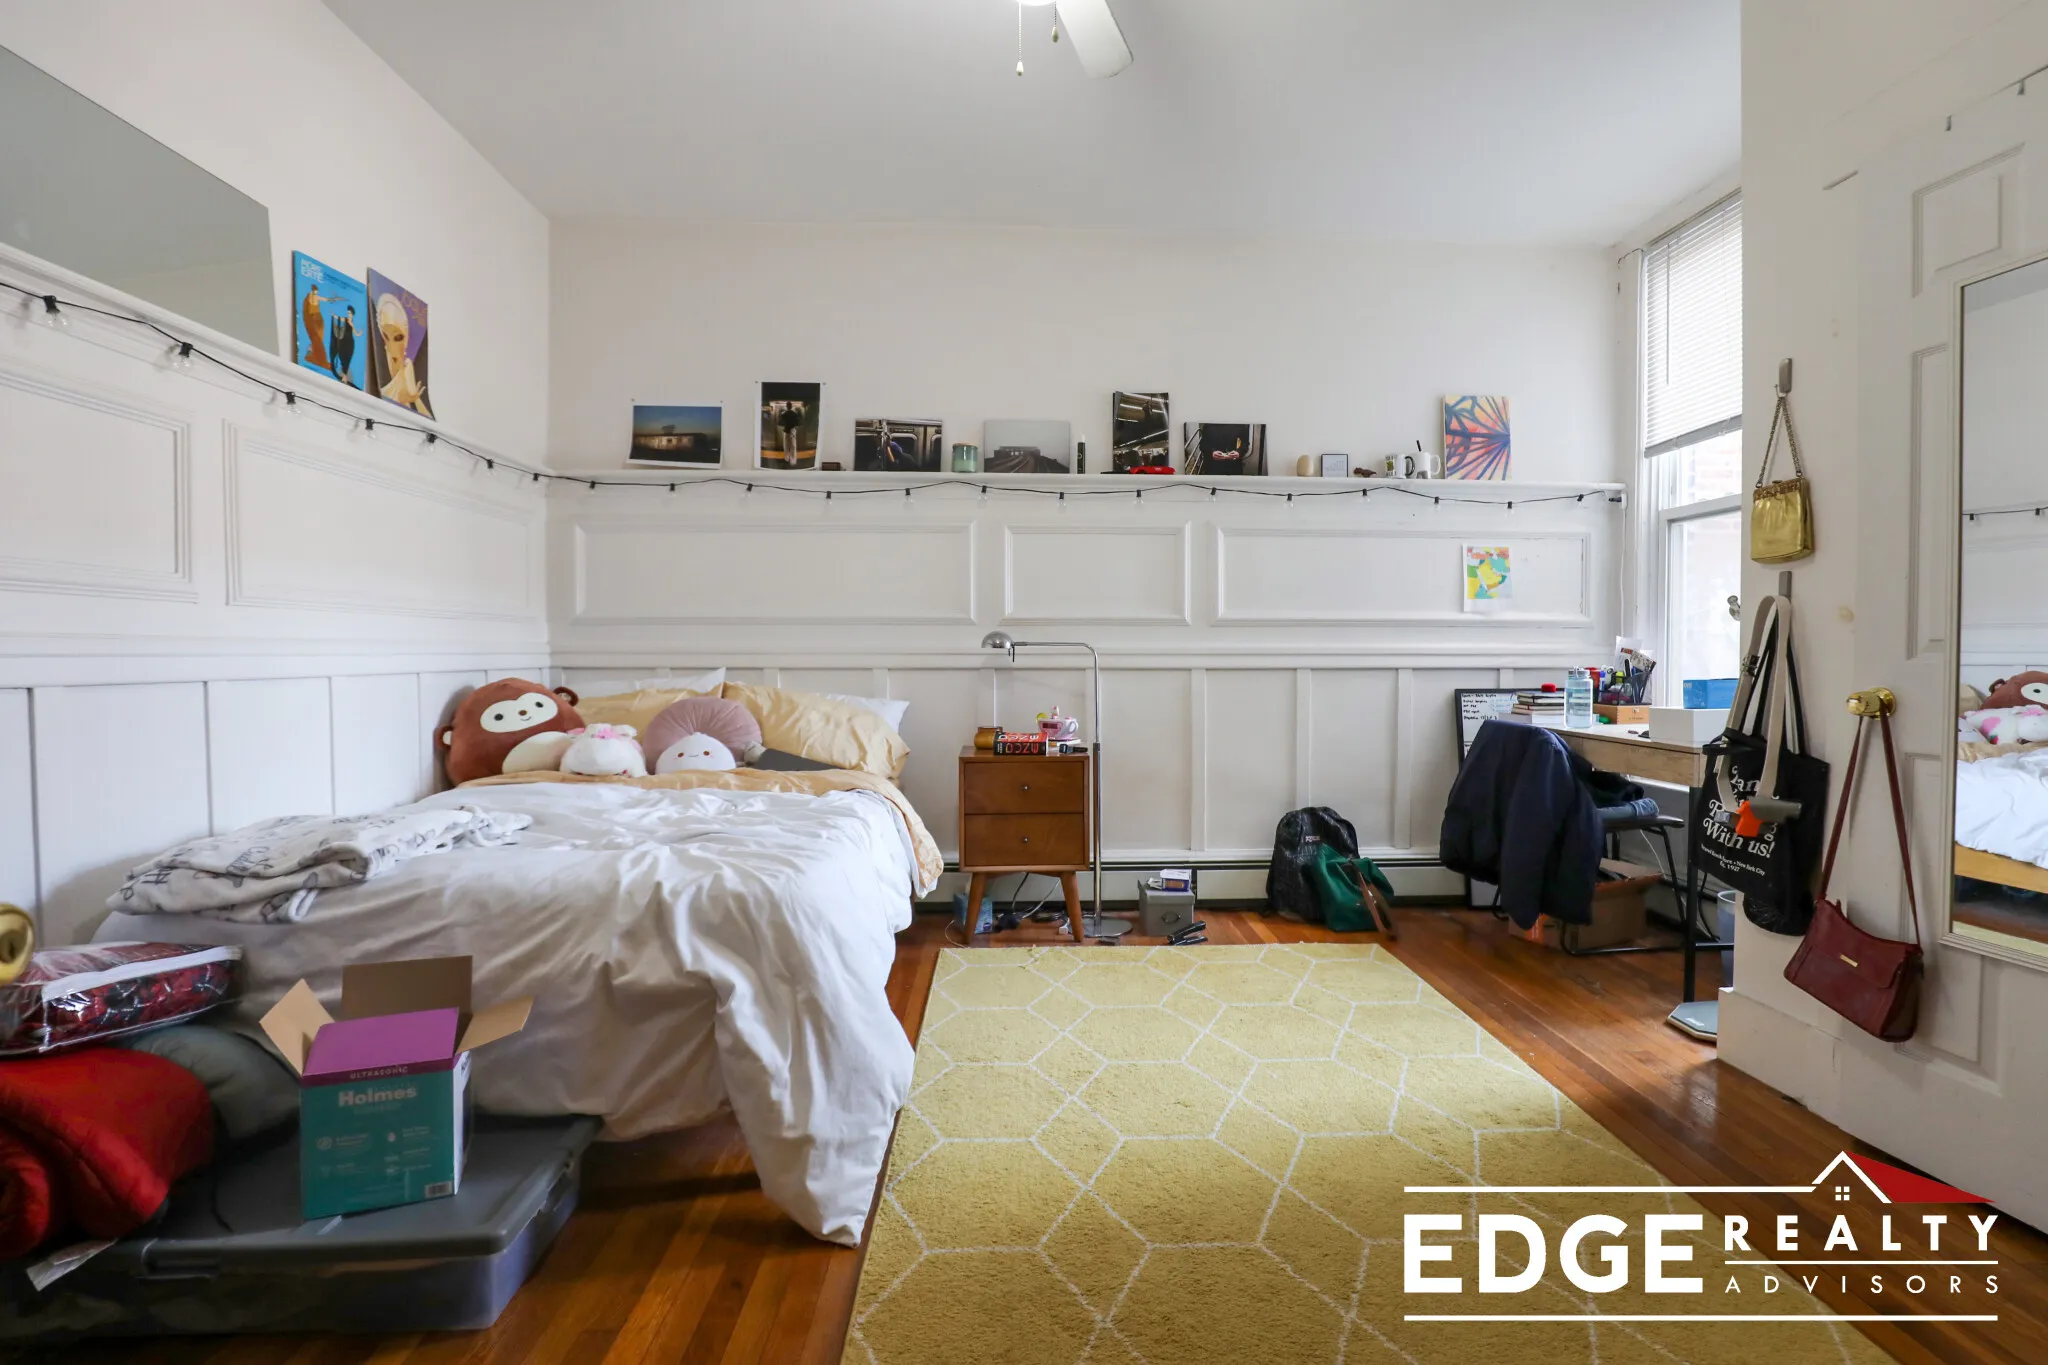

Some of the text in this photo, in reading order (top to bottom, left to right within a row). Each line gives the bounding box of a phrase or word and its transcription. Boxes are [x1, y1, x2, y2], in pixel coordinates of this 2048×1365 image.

[1702, 817, 1775, 858] With us!
[1727, 864, 1740, 872] 1927
[1736, 860, 1746, 868] New
[1755, 867, 1766, 877] City
[350, 1066, 409, 1080] ULTRASONIC
[338, 1087, 417, 1108] Holmes
